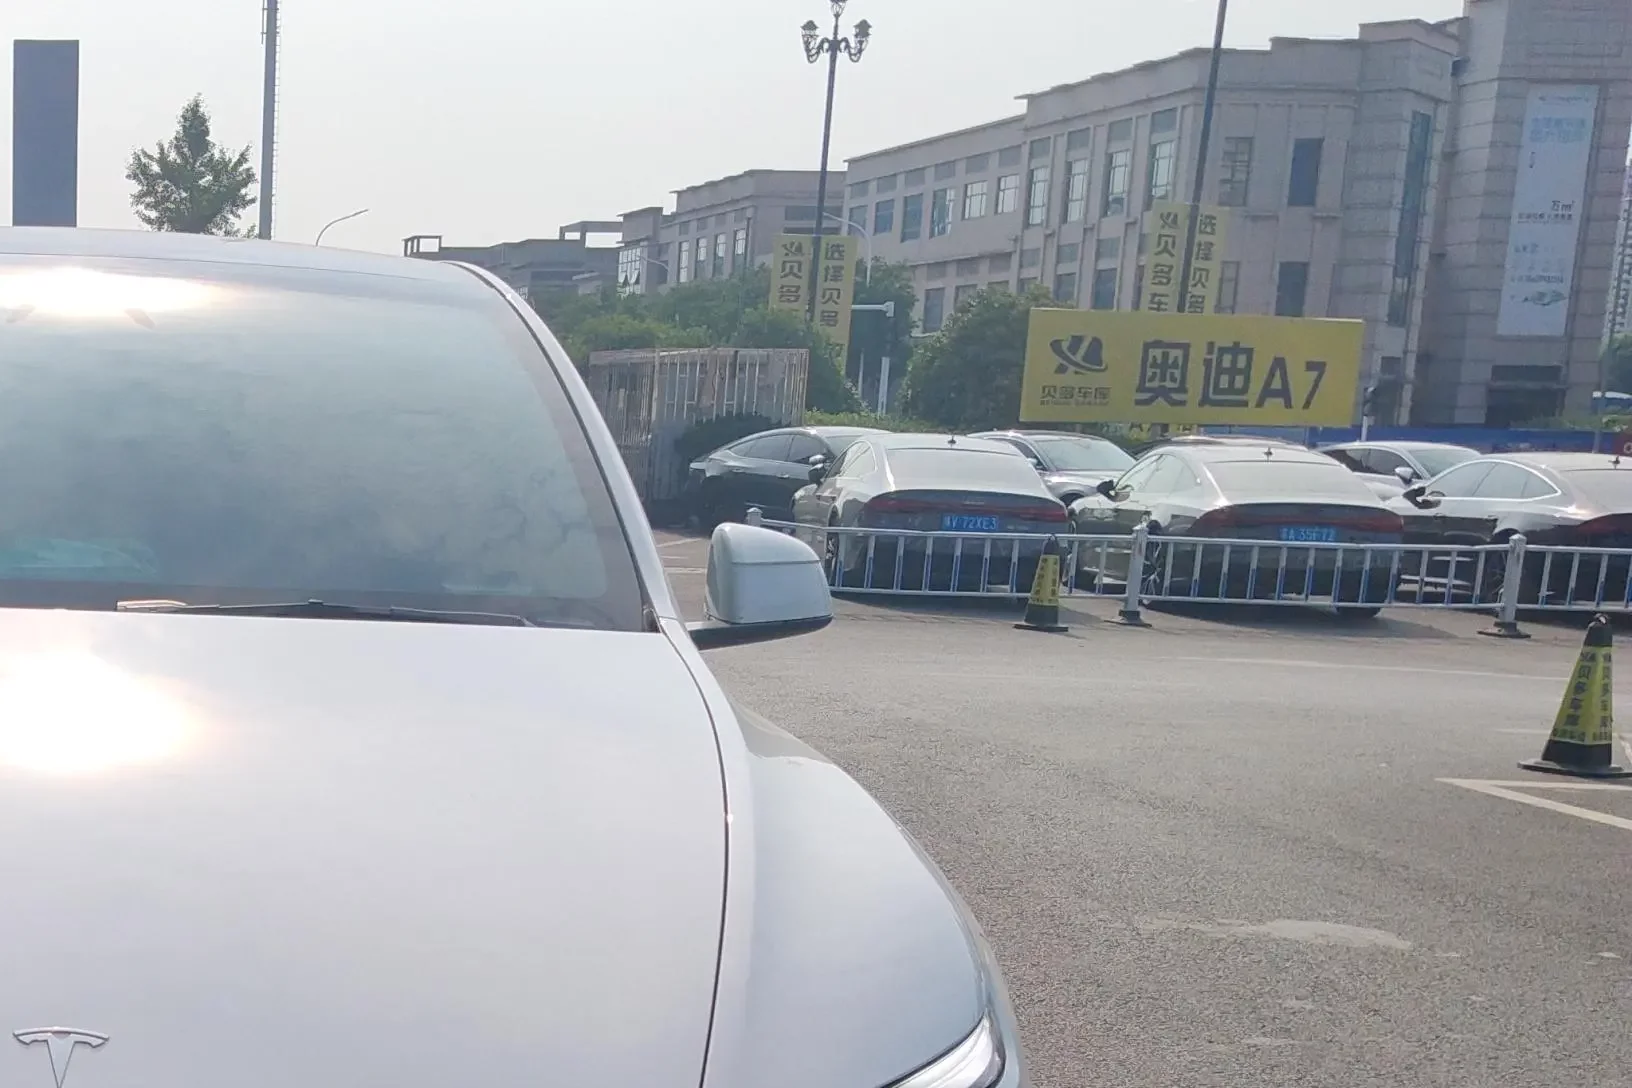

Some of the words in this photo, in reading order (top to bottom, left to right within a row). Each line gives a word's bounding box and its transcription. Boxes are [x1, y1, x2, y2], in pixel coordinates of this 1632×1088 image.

[819, 242, 845, 327] 选择贝多
[1134, 339, 1328, 410] 奥迪A7
